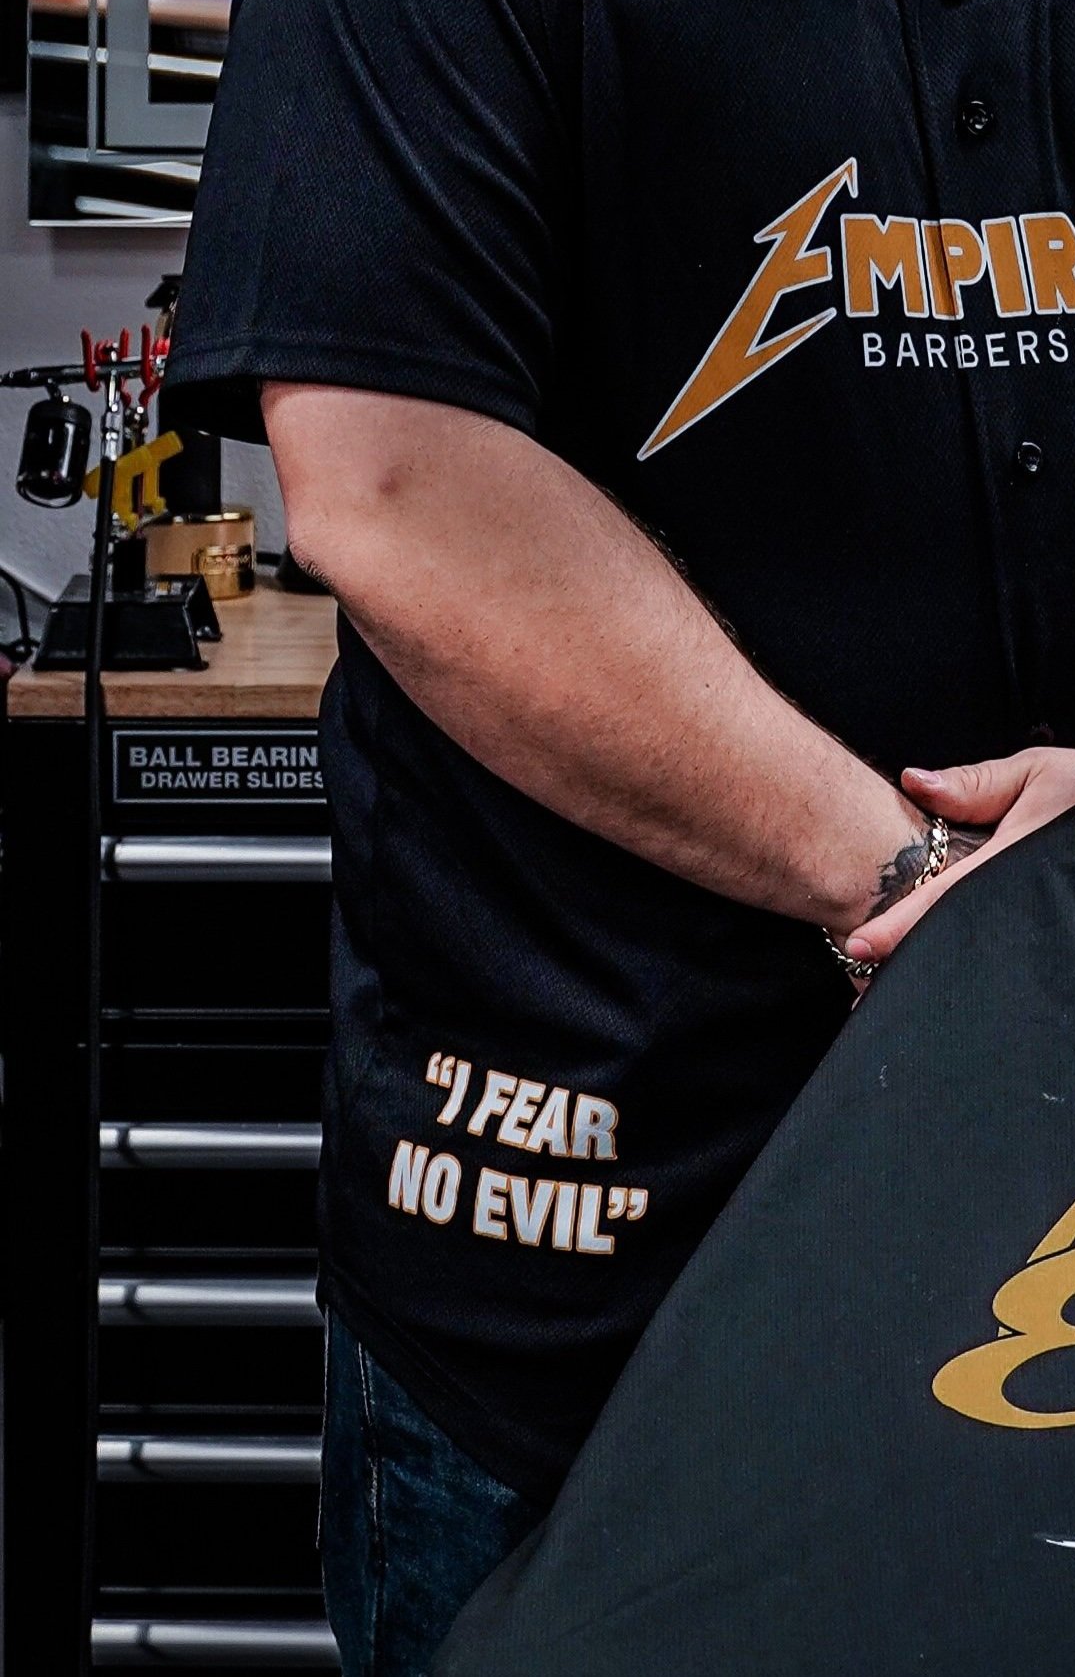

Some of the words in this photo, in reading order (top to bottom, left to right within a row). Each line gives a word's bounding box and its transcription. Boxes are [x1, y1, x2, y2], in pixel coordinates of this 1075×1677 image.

[129, 746, 202, 767] BALL
[211, 746, 320, 768] BEARIN
[141, 771, 240, 790] DRAWER
[246, 771, 324, 790] SLIDES
[466, 1069, 619, 1161] FEAR
[388, 1139, 462, 1225] NO
